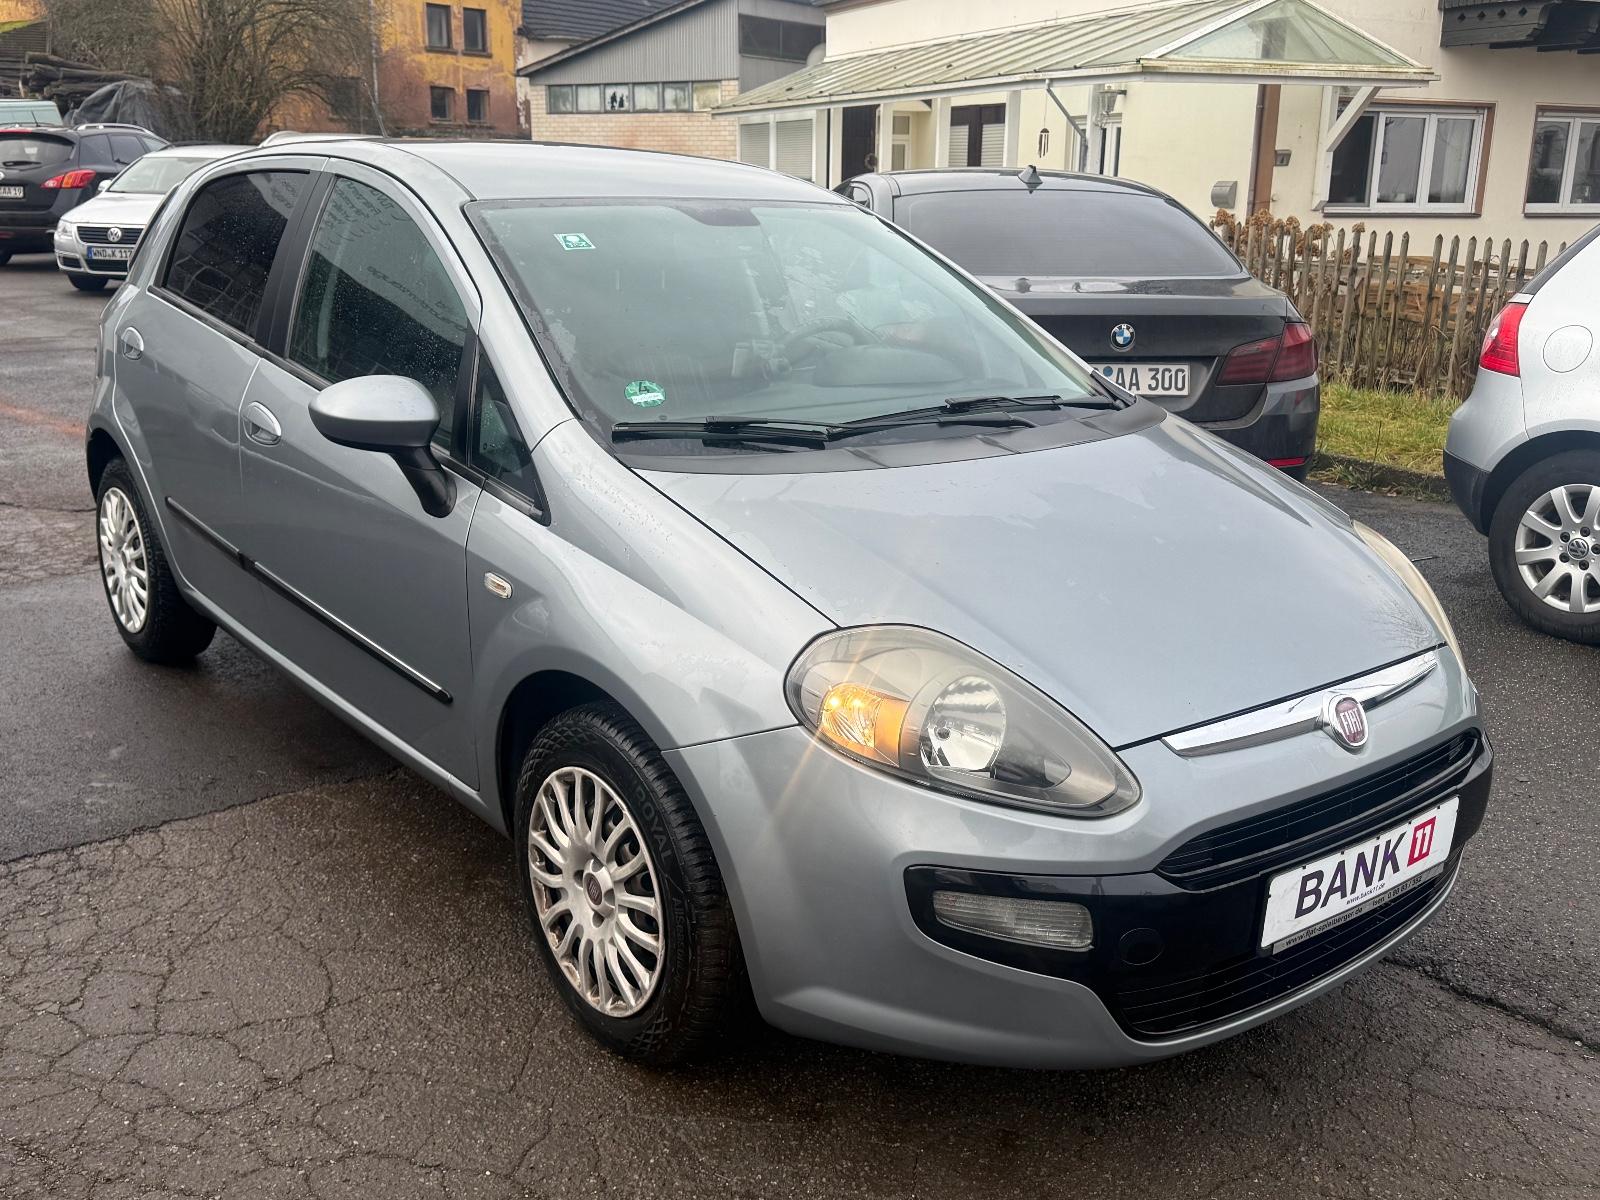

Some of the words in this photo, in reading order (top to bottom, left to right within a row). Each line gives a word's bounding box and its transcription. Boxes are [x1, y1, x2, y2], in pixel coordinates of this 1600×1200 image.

[1115, 367, 1140, 391] AA
[1147, 367, 1186, 391] 300
[1339, 707, 1363, 735] FIAT
[1295, 831, 1407, 919] BANK
[1410, 820, 1434, 863] 11
